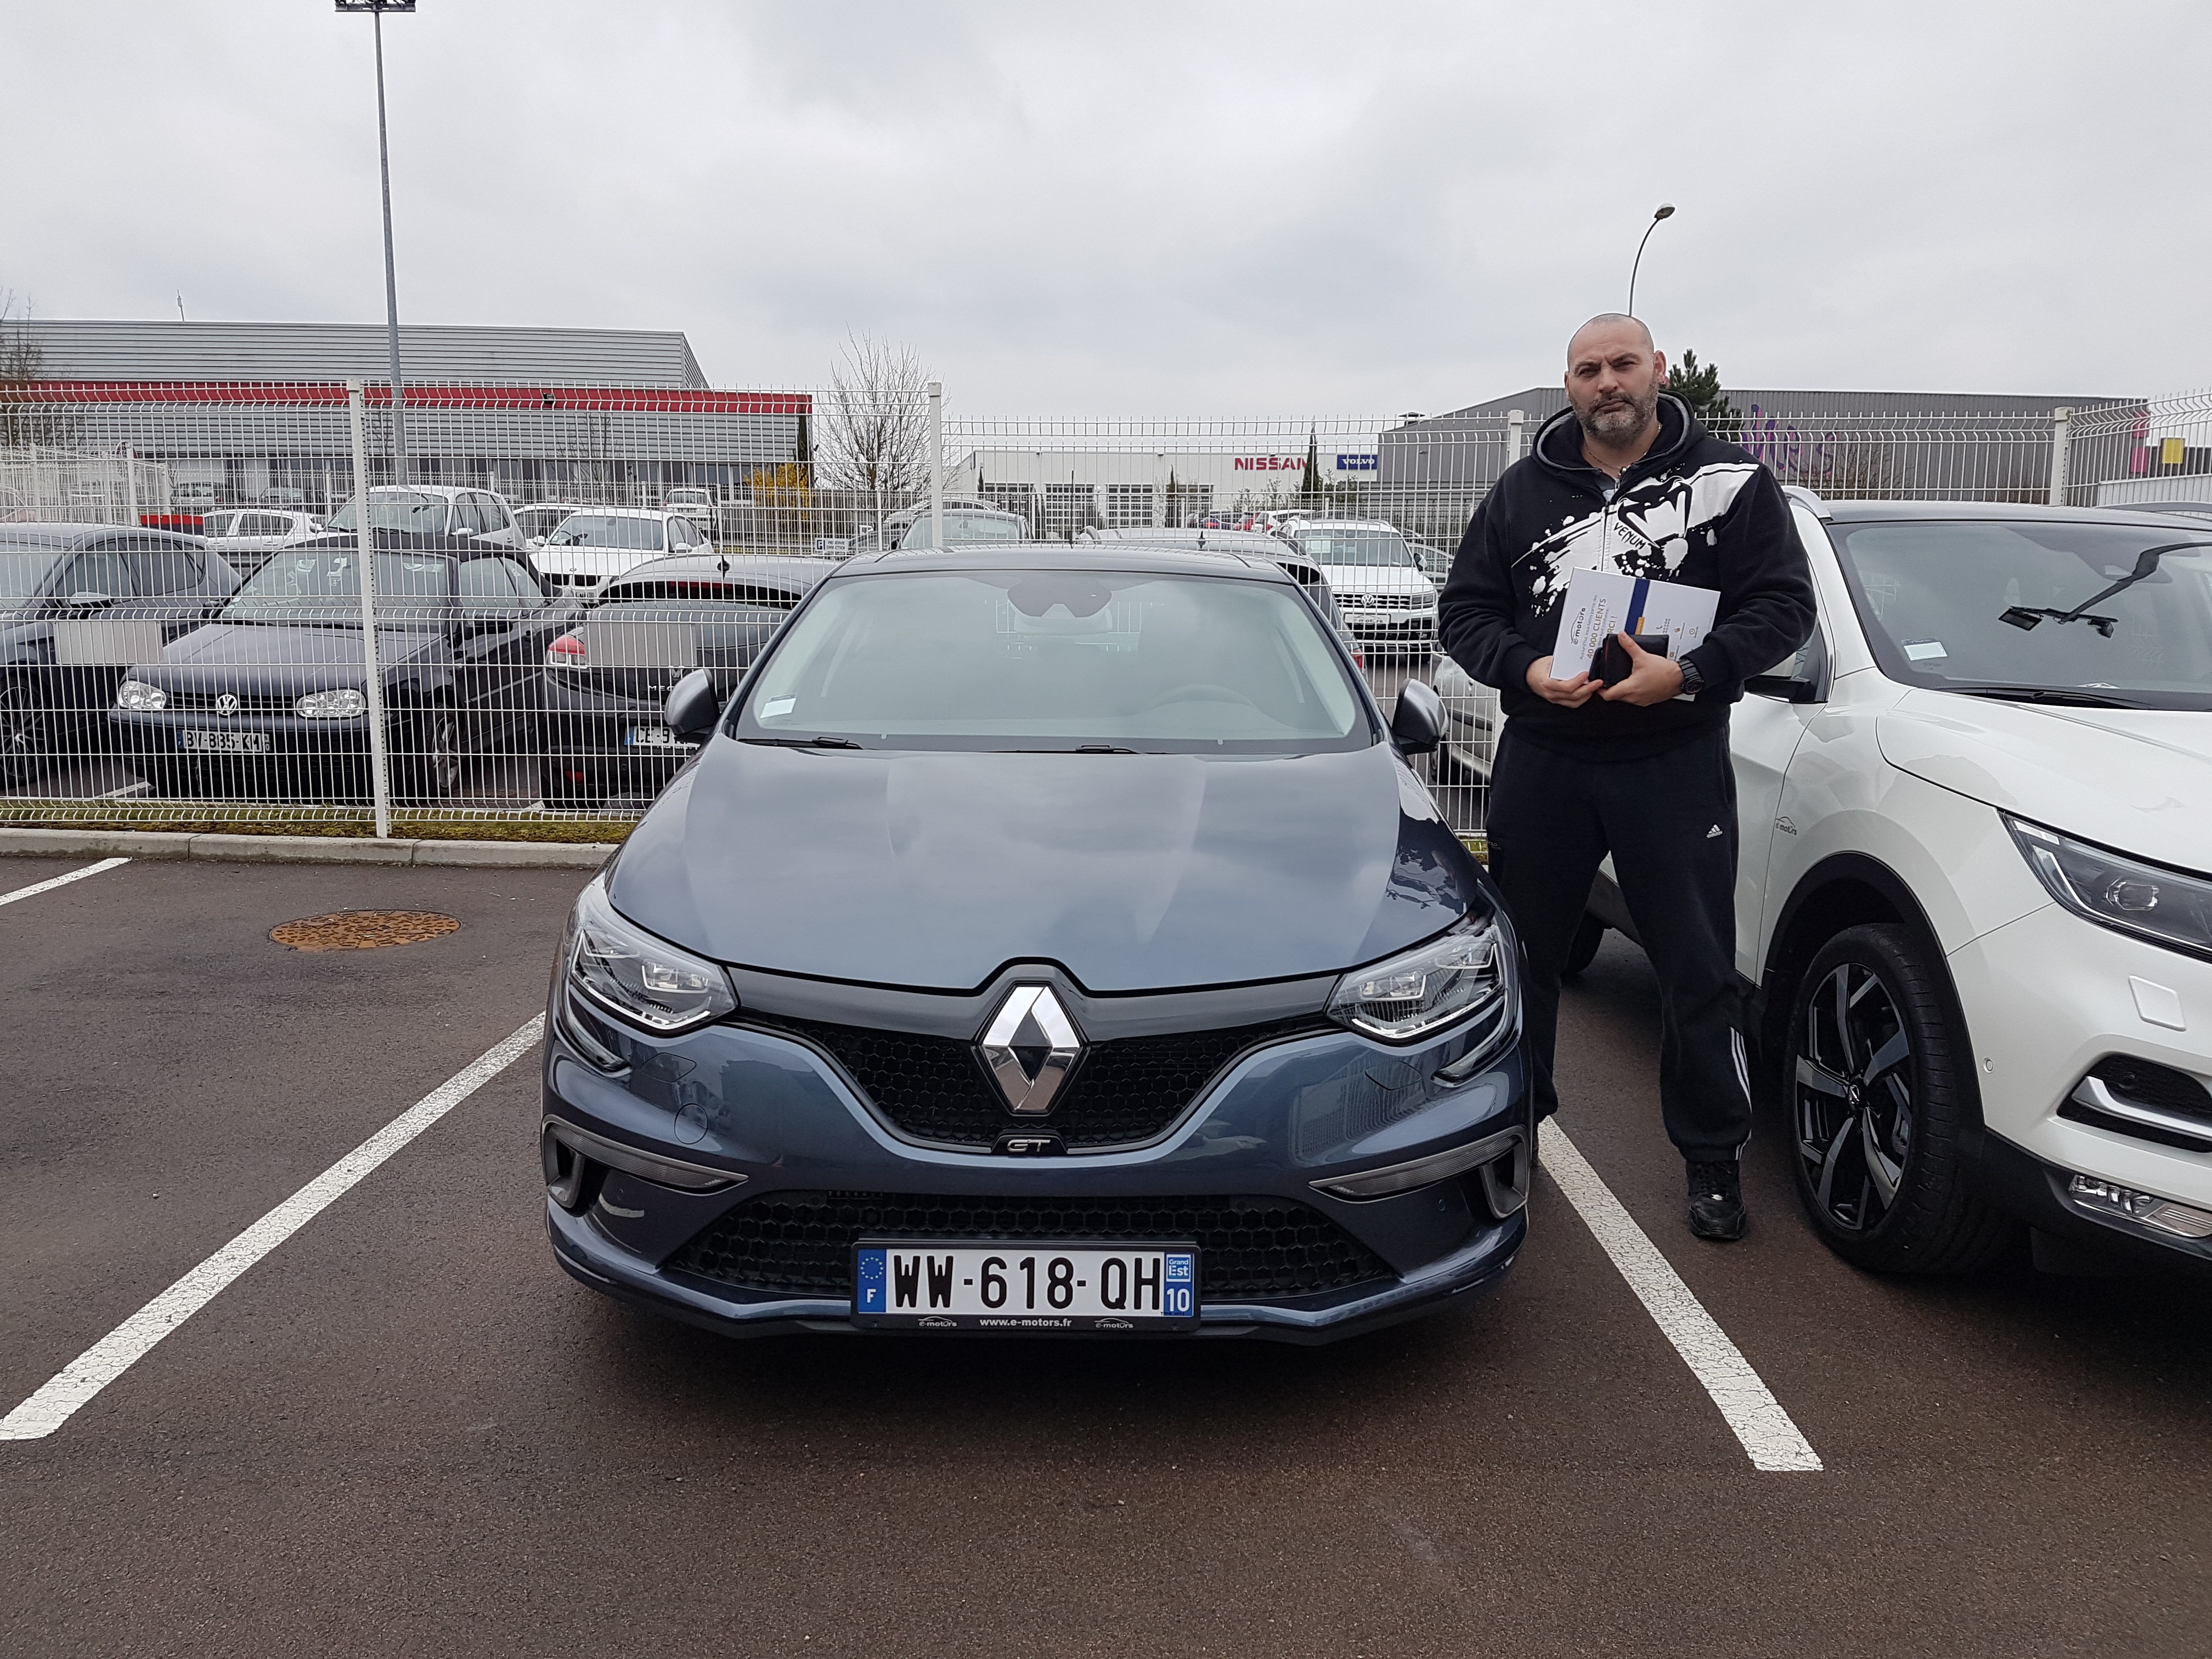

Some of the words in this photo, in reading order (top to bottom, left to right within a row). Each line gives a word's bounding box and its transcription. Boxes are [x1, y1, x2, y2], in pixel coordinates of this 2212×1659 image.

[1235, 458, 1307, 470] NISSAN
[1613, 522, 1646, 550] VENUM
[1593, 598, 1606, 631] CLIENTS
[1607, 620, 1616, 634] RCI
[1589, 633, 1598, 647] 000
[1586, 648, 1594, 659] 40
[1007, 1139, 1051, 1153] GT
[1169, 1265, 1189, 1276] Est
[866, 1288, 876, 1304] F
[1167, 1288, 1190, 1312] 10
[979, 1318, 1072, 1327] www.e-motors.fr
